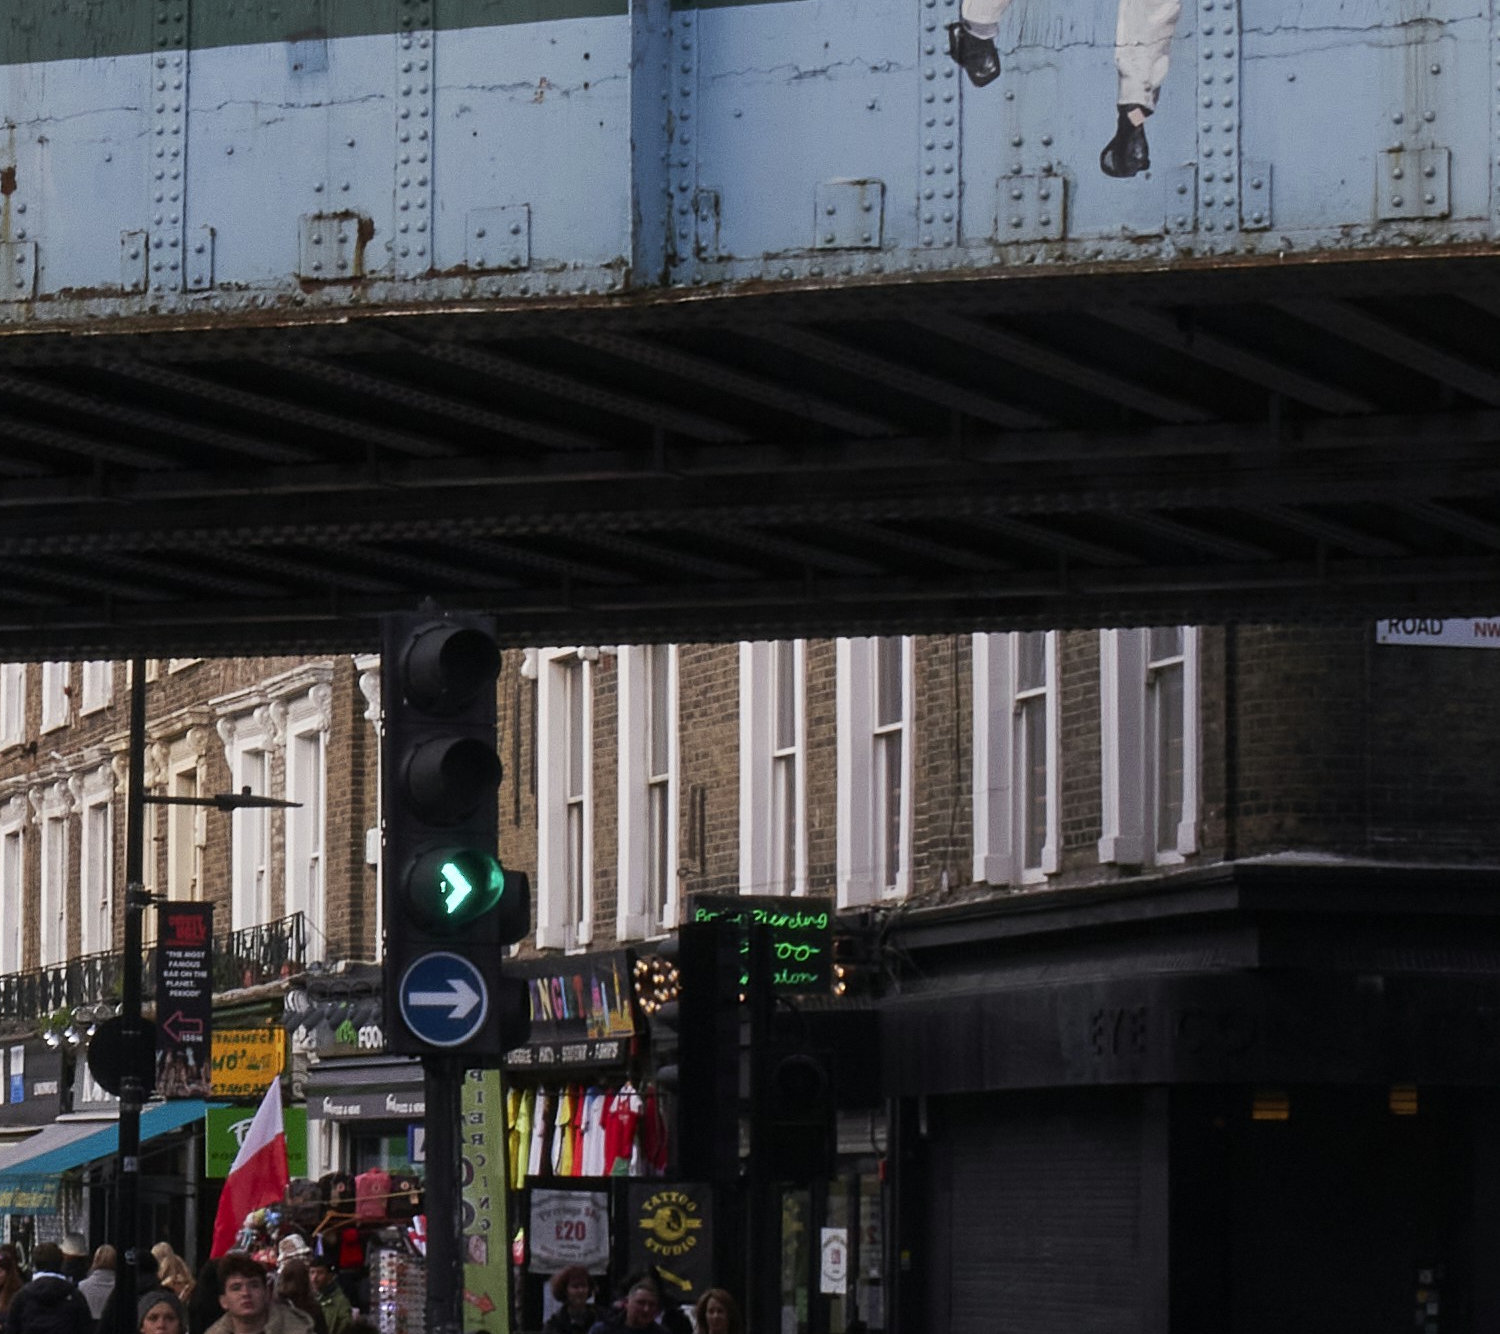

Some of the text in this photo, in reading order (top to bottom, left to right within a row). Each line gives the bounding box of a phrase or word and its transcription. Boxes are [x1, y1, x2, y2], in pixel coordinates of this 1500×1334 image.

[1388, 619, 1443, 635] ROAD
[642, 1191, 698, 1213] TATTOO
[555, 1221, 586, 1241] £20
[644, 1235, 698, 1257] STUDIO
